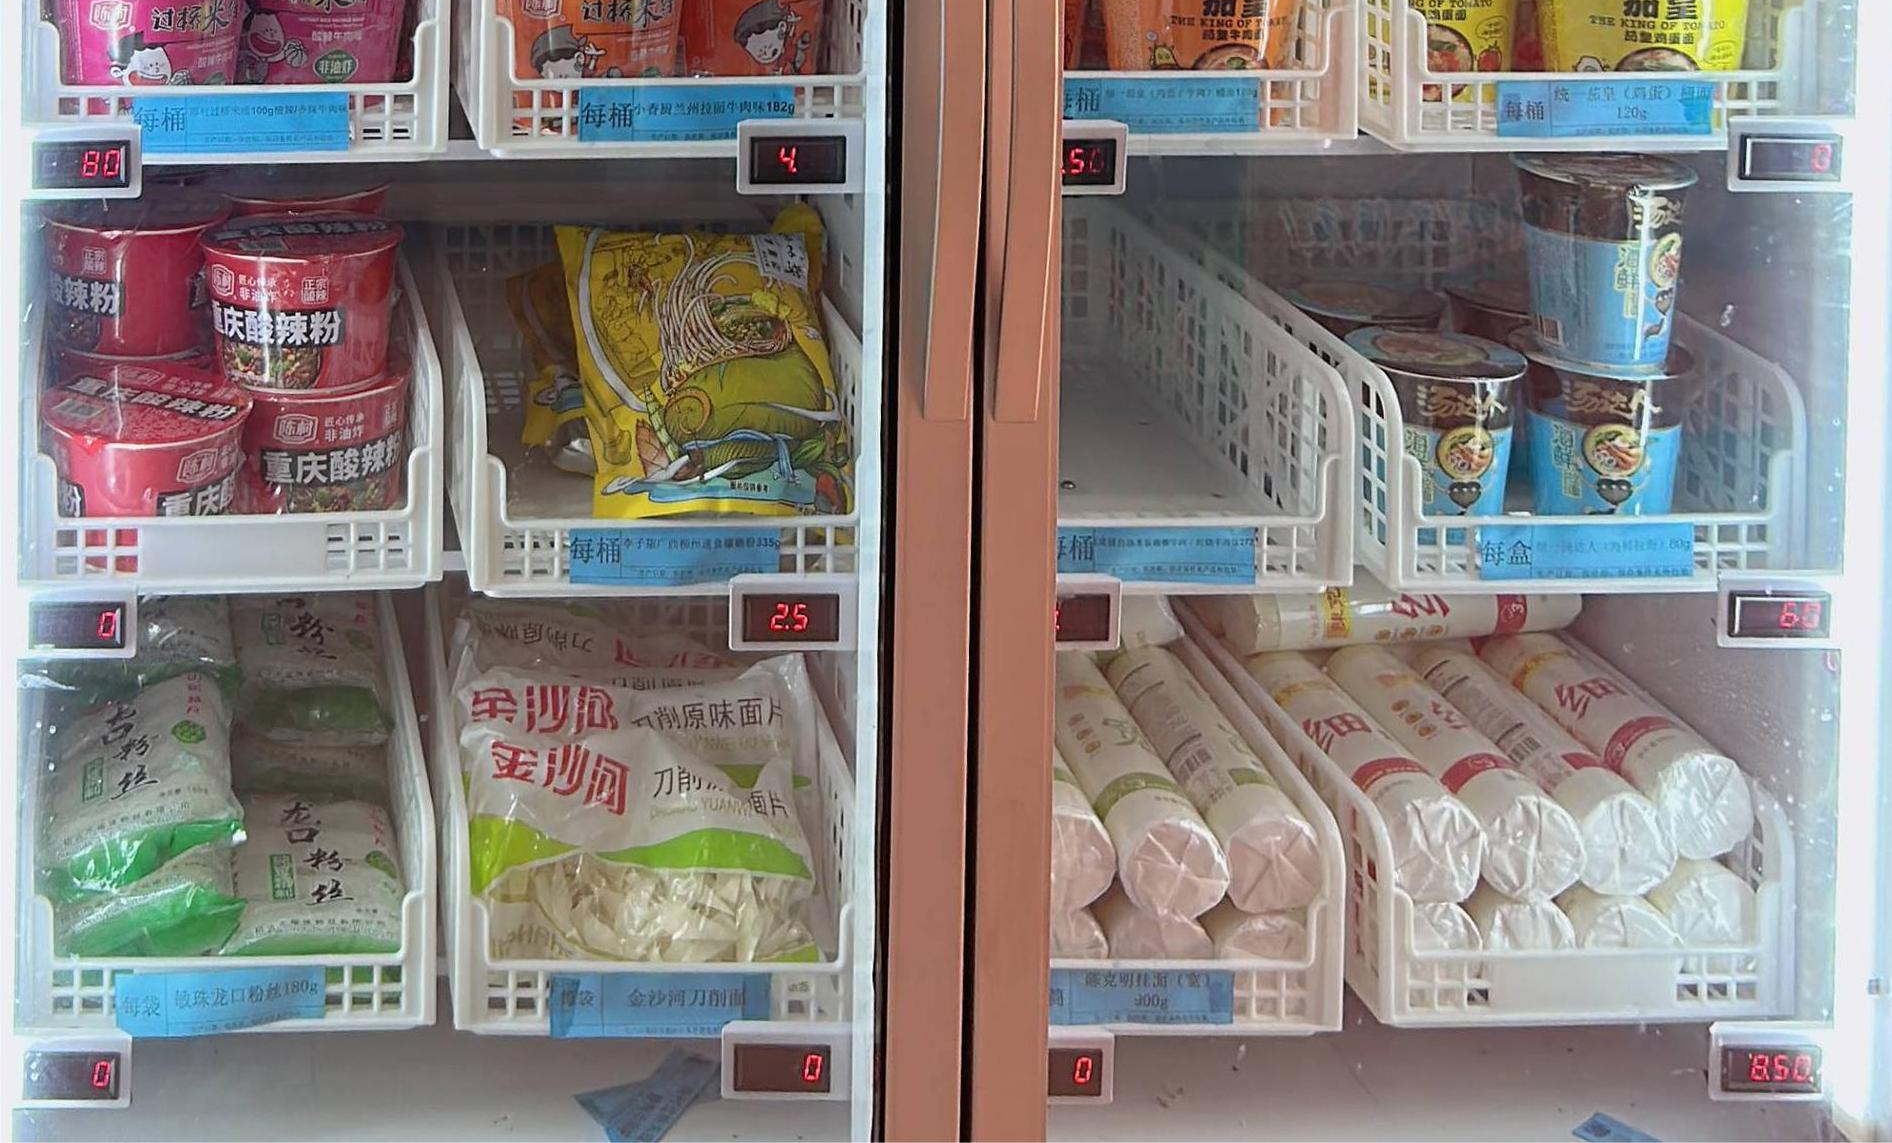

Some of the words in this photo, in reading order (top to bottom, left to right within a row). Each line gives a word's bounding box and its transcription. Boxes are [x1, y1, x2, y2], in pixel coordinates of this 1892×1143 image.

[1429, 0, 1444, 8] OF
[1200, 18, 1232, 28] KING
[1589, 16, 1615, 27] THE
[1621, 18, 1655, 29] KING
[1661, 20, 1677, 30] OF
[134, 106, 185, 132] 每桶
[582, 102, 633, 128] 每桶
[1504, 101, 1545, 121] 每桶
[1616, 106, 1648, 120] 120g
[81, 150, 121, 178] 80
[212, 300, 342, 345] 重庆酸辣粉
[571, 536, 620, 564] 每桶
[1483, 540, 1532, 565] 每盒
[99, 612, 115, 638] 0
[770, 603, 808, 631] 2.5
[492, 740, 631, 816] 金沙河
[629, 987, 747, 1007] 金沙河刀削面
[92, 1061, 110, 1088] 0
[803, 1053, 822, 1081] 0
[1074, 1056, 1093, 1083] 0
